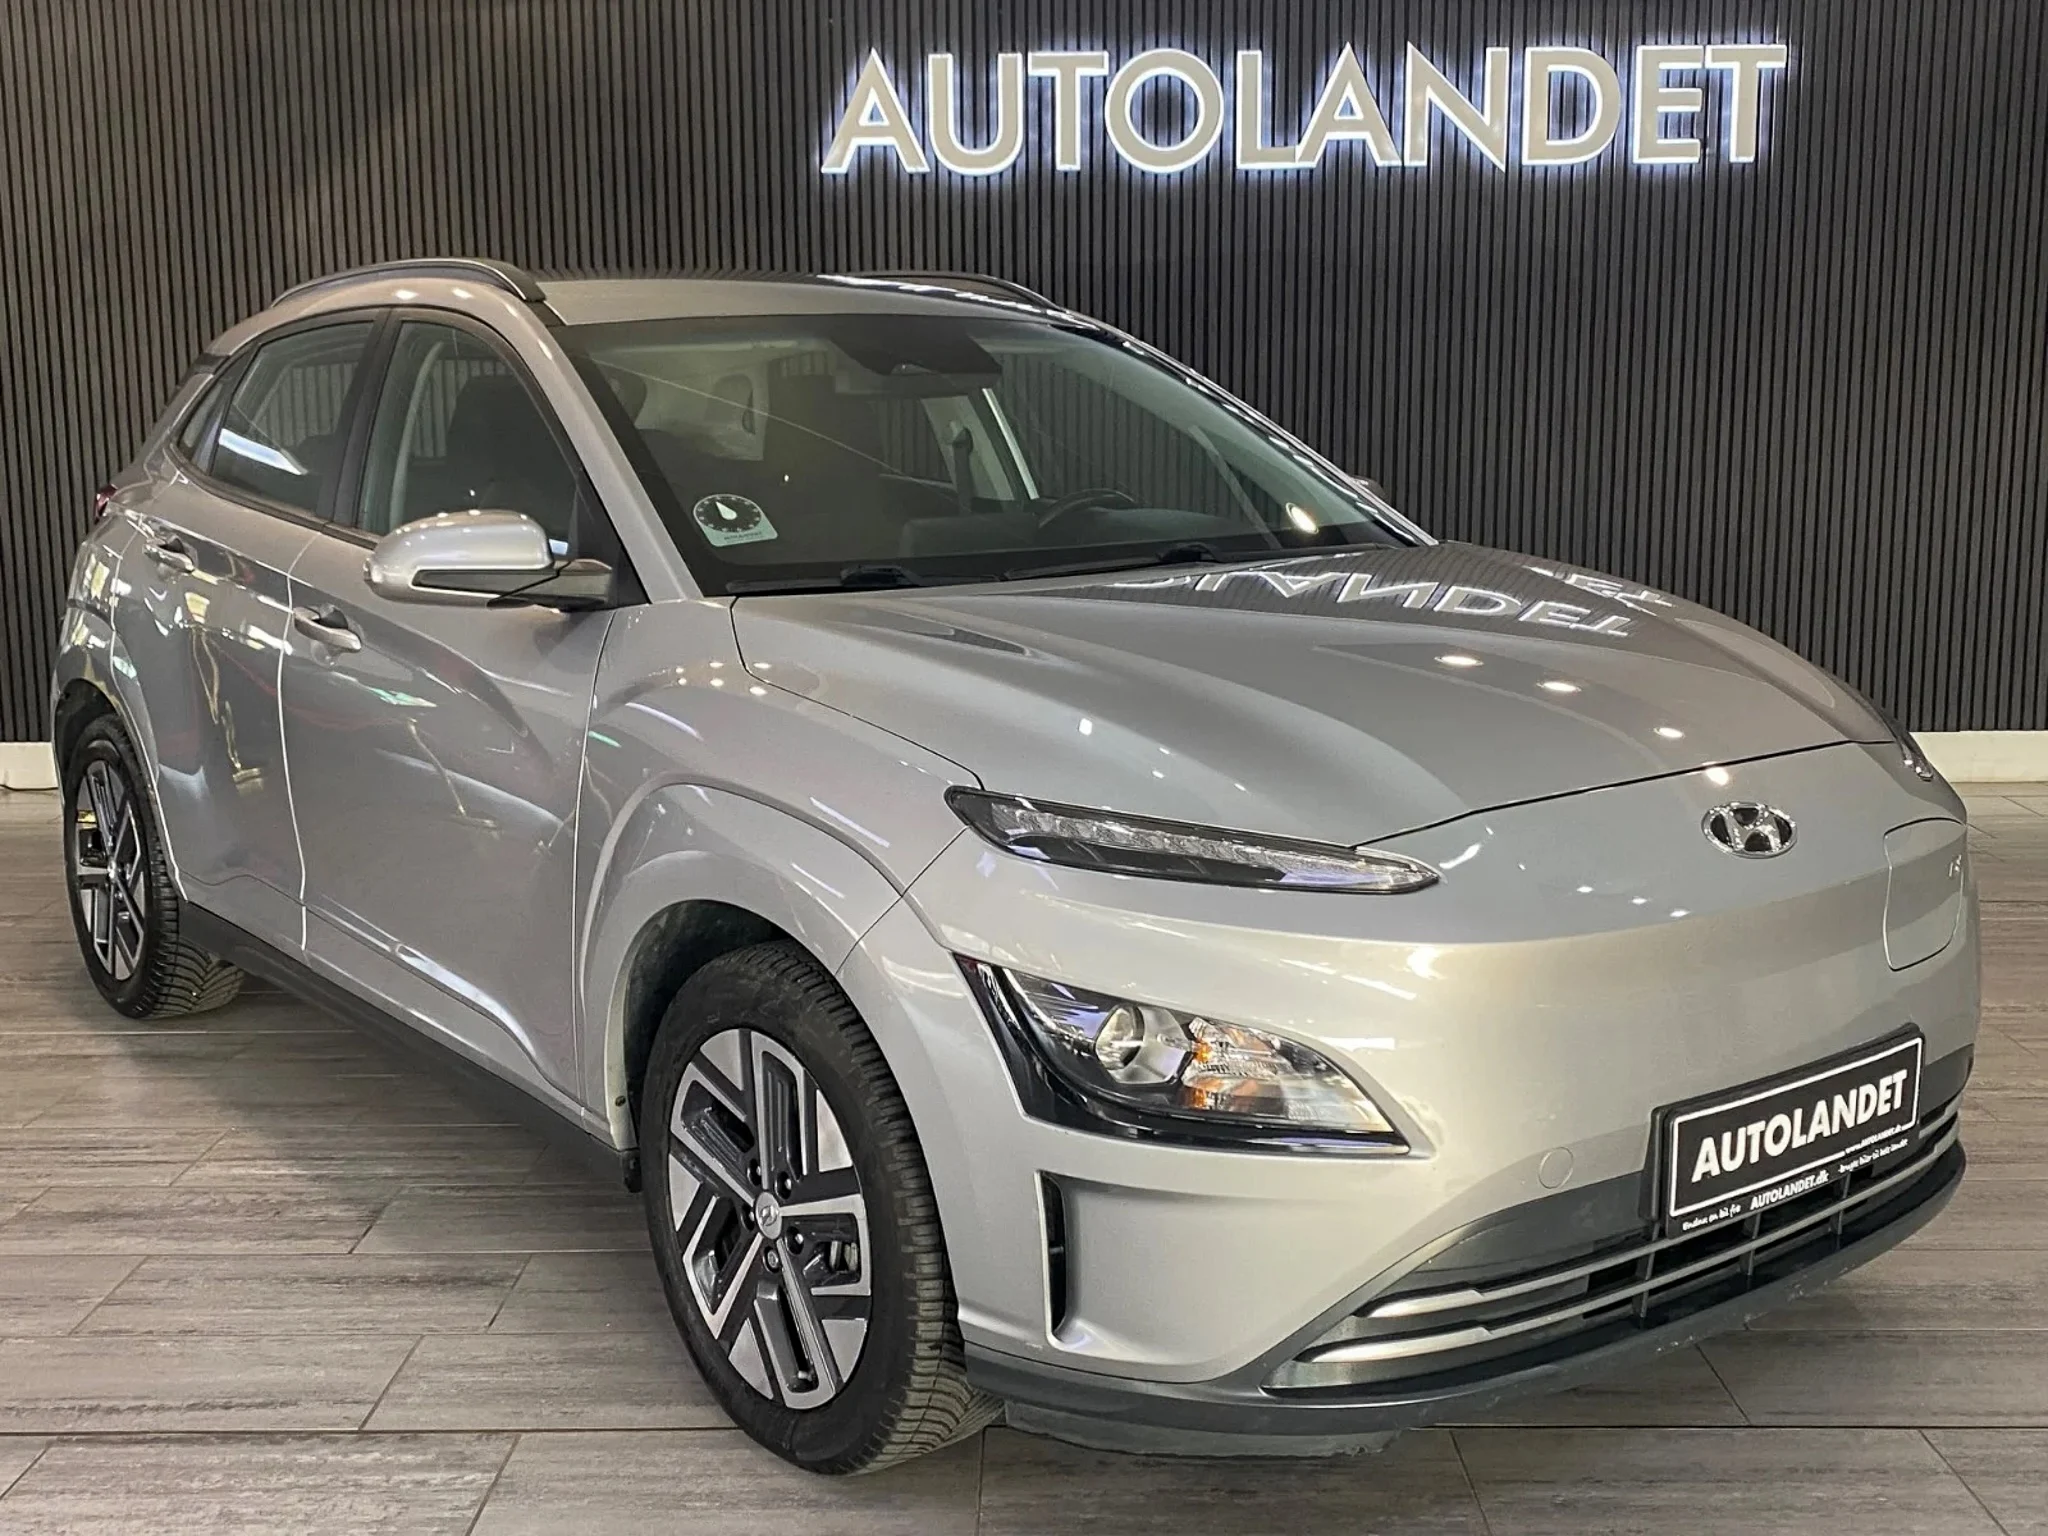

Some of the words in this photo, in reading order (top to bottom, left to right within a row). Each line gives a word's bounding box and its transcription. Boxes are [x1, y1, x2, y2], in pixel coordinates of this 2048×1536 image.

[820, 41, 1788, 176] AUTOLANDET
[1691, 1069, 1909, 1184] AUTOLANDET
[1750, 1169, 1830, 1211] AUTOLANDET.dk
